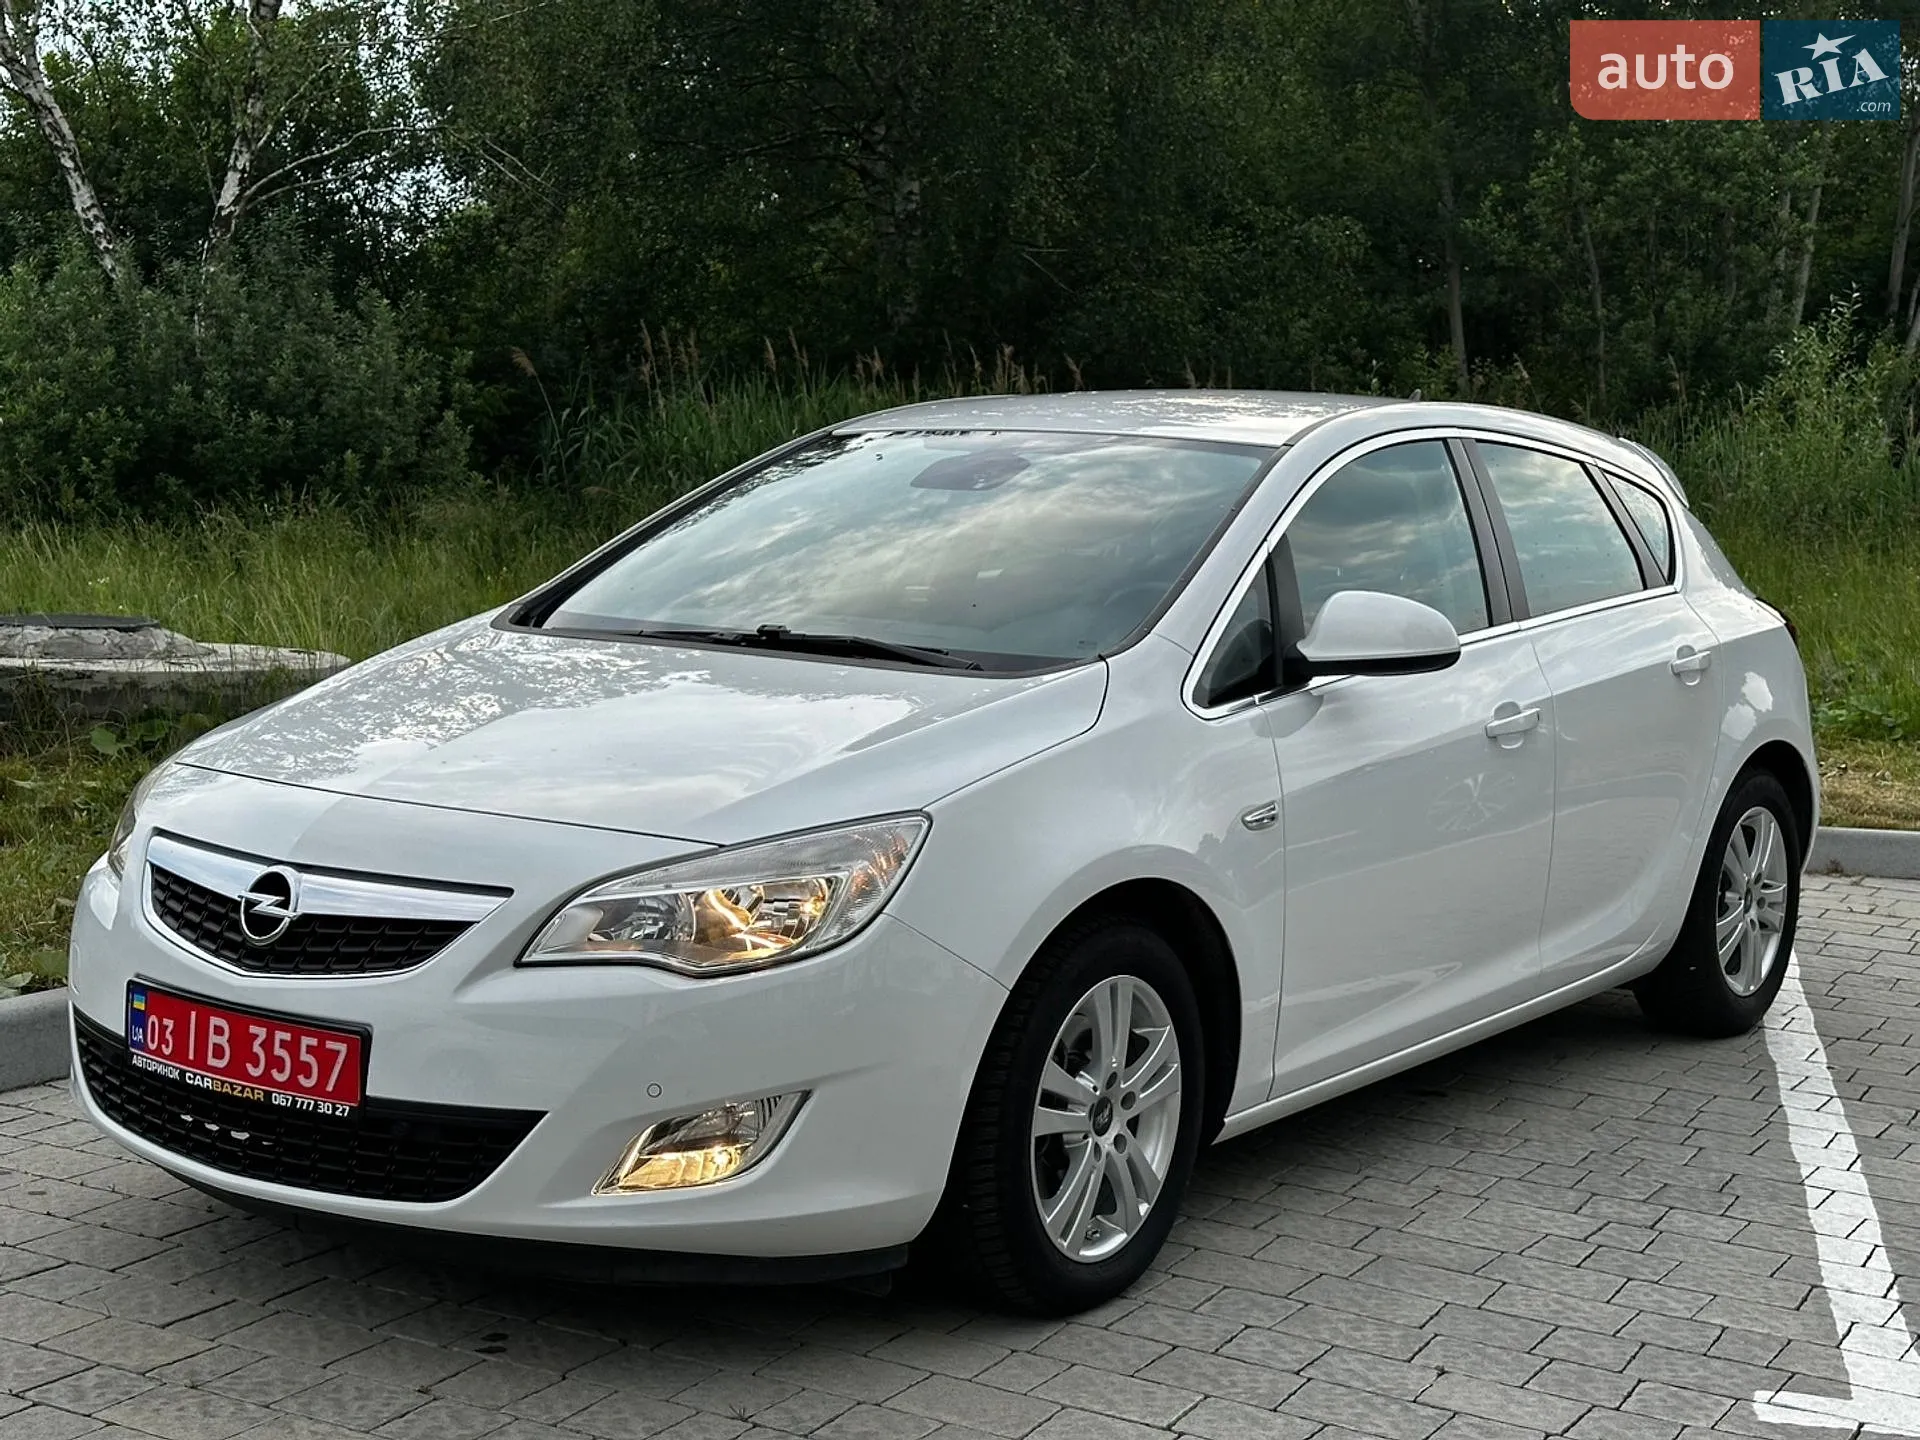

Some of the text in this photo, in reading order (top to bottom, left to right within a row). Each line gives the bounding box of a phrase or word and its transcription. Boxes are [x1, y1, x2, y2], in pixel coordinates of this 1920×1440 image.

[131, 1024, 144, 1043] UA
[147, 1014, 175, 1056] 03
[245, 1025, 348, 1093] 3557
[131, 1054, 180, 1081] АВТОРИНОК
[271, 1092, 292, 1108] 067
[293, 1096, 314, 1112] 777
[317, 1101, 332, 1115] 30
[335, 1104, 350, 1117] 27
